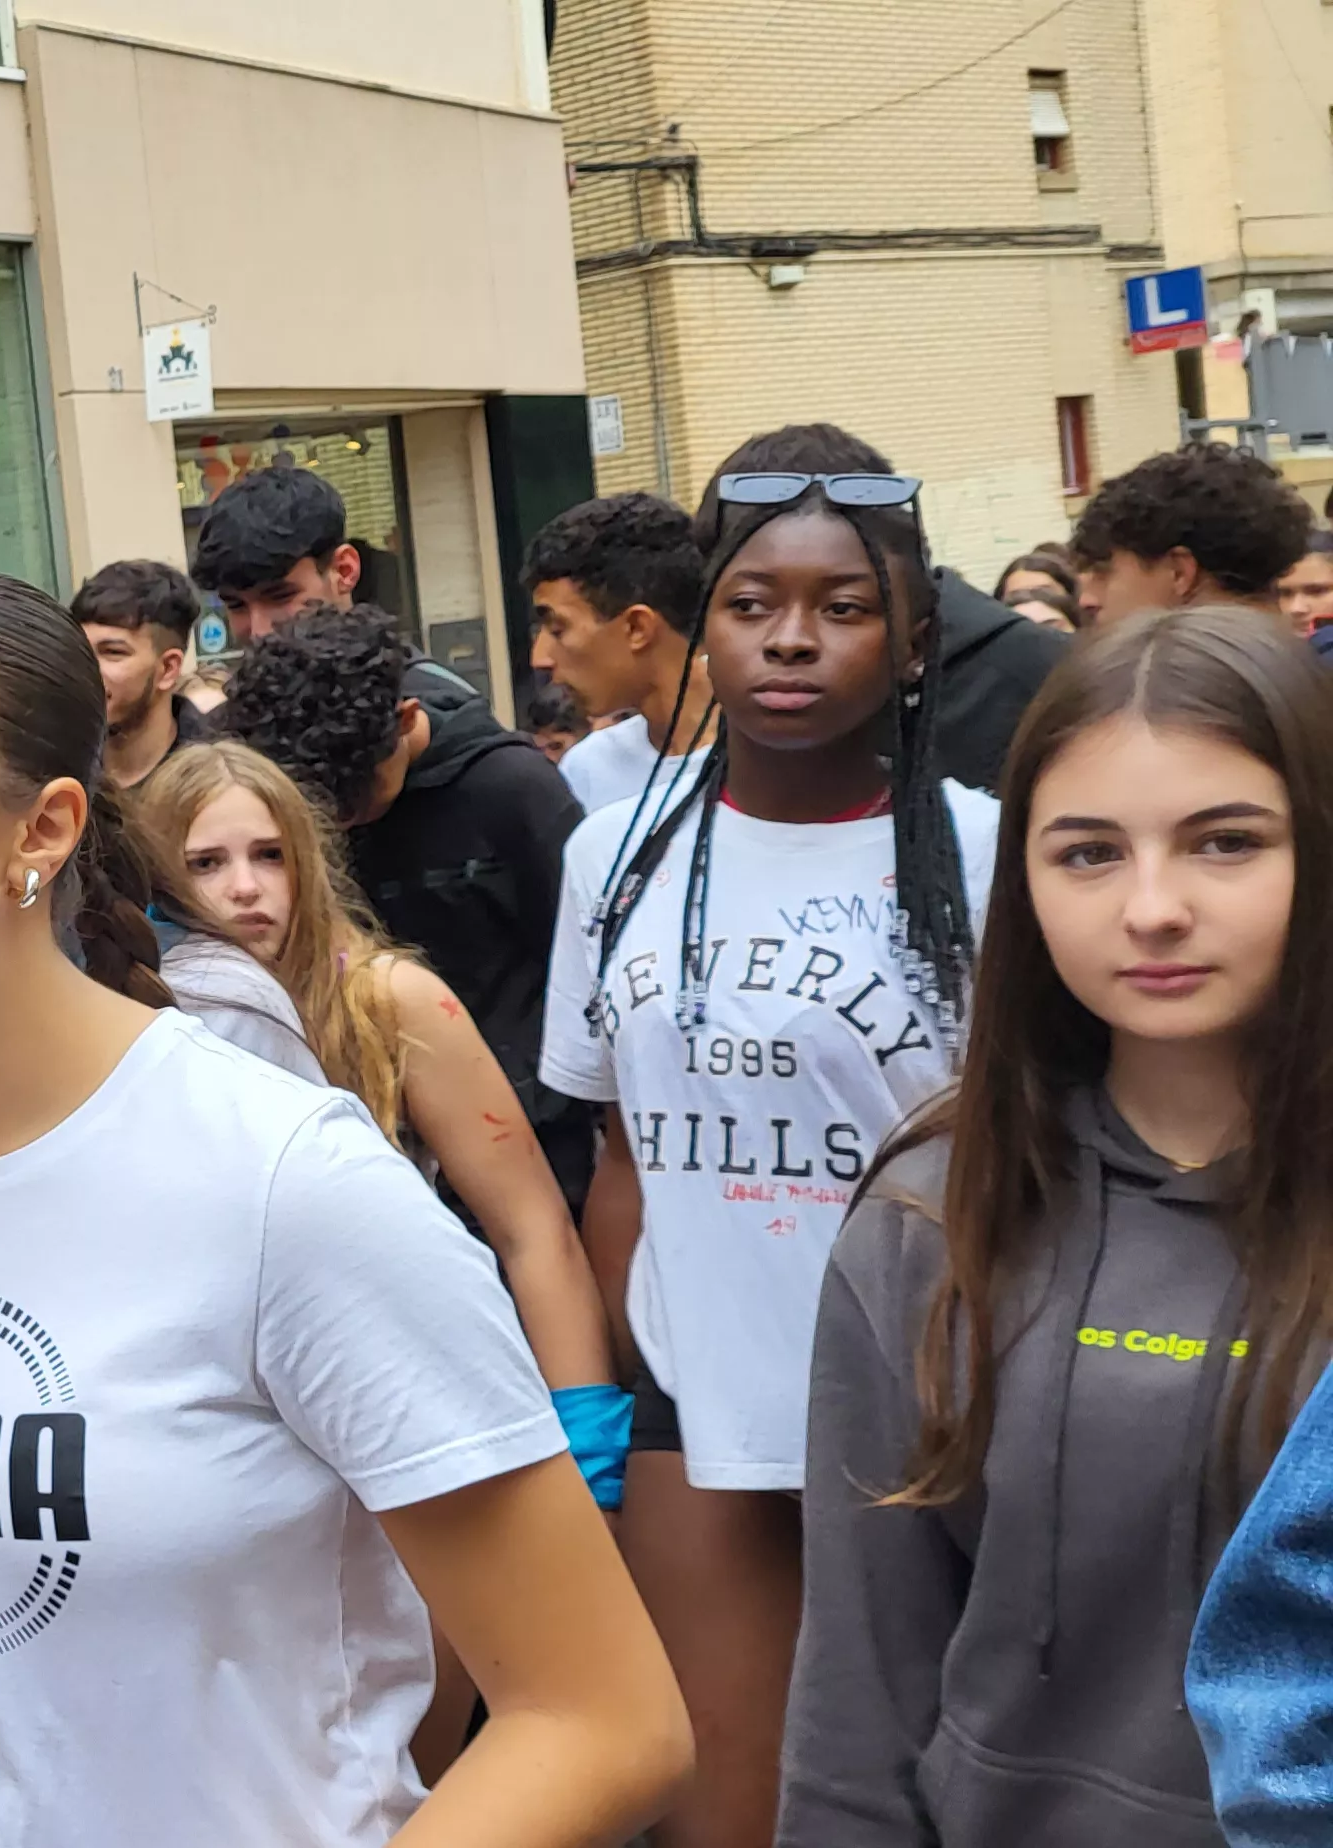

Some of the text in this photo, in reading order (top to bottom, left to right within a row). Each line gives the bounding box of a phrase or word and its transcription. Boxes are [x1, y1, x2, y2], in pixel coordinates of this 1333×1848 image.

[685, 1035, 798, 1078] 1995
[633, 1112, 865, 1182] HILLS
[1076, 1327, 1118, 1349] os
